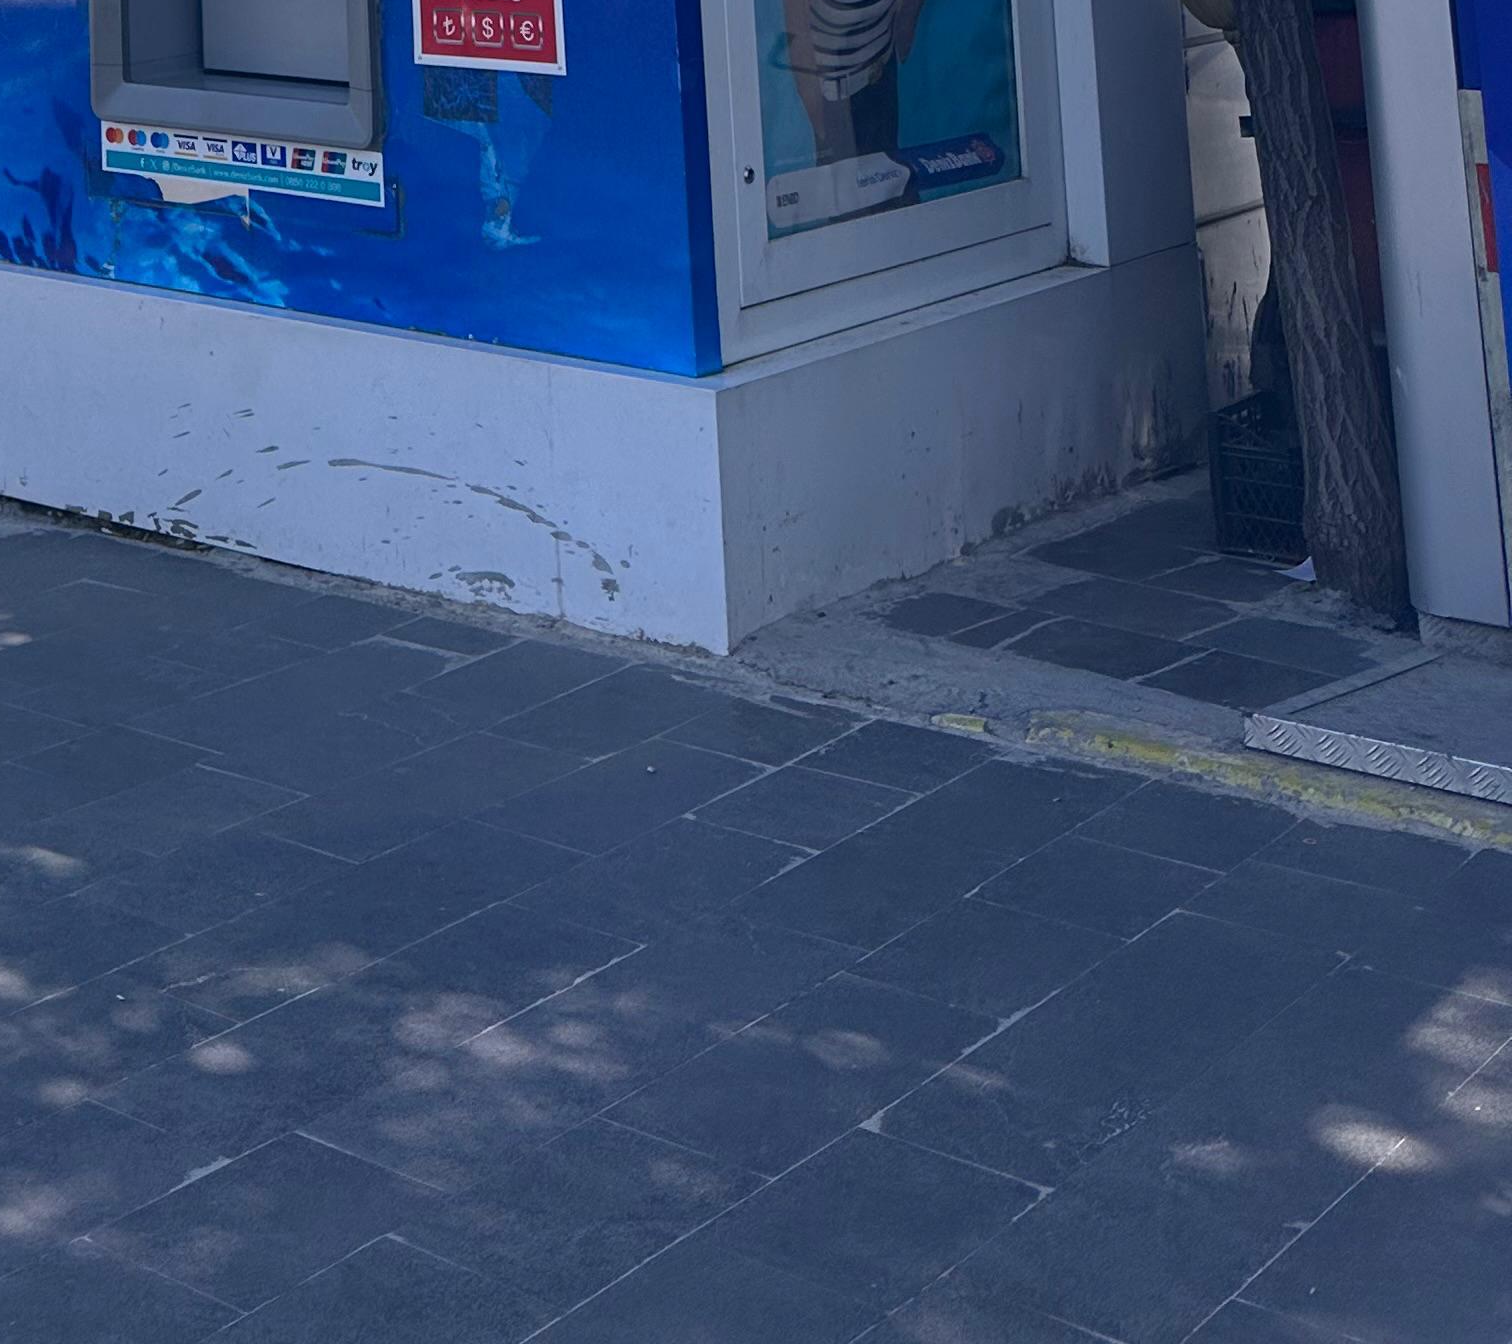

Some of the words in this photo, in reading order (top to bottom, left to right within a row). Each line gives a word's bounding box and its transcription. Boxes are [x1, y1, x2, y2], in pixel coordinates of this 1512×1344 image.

[176, 140, 196, 151] VISA
[206, 143, 224, 153] VISA
[239, 152, 257, 163] PLUS
[351, 157, 378, 176] troy
